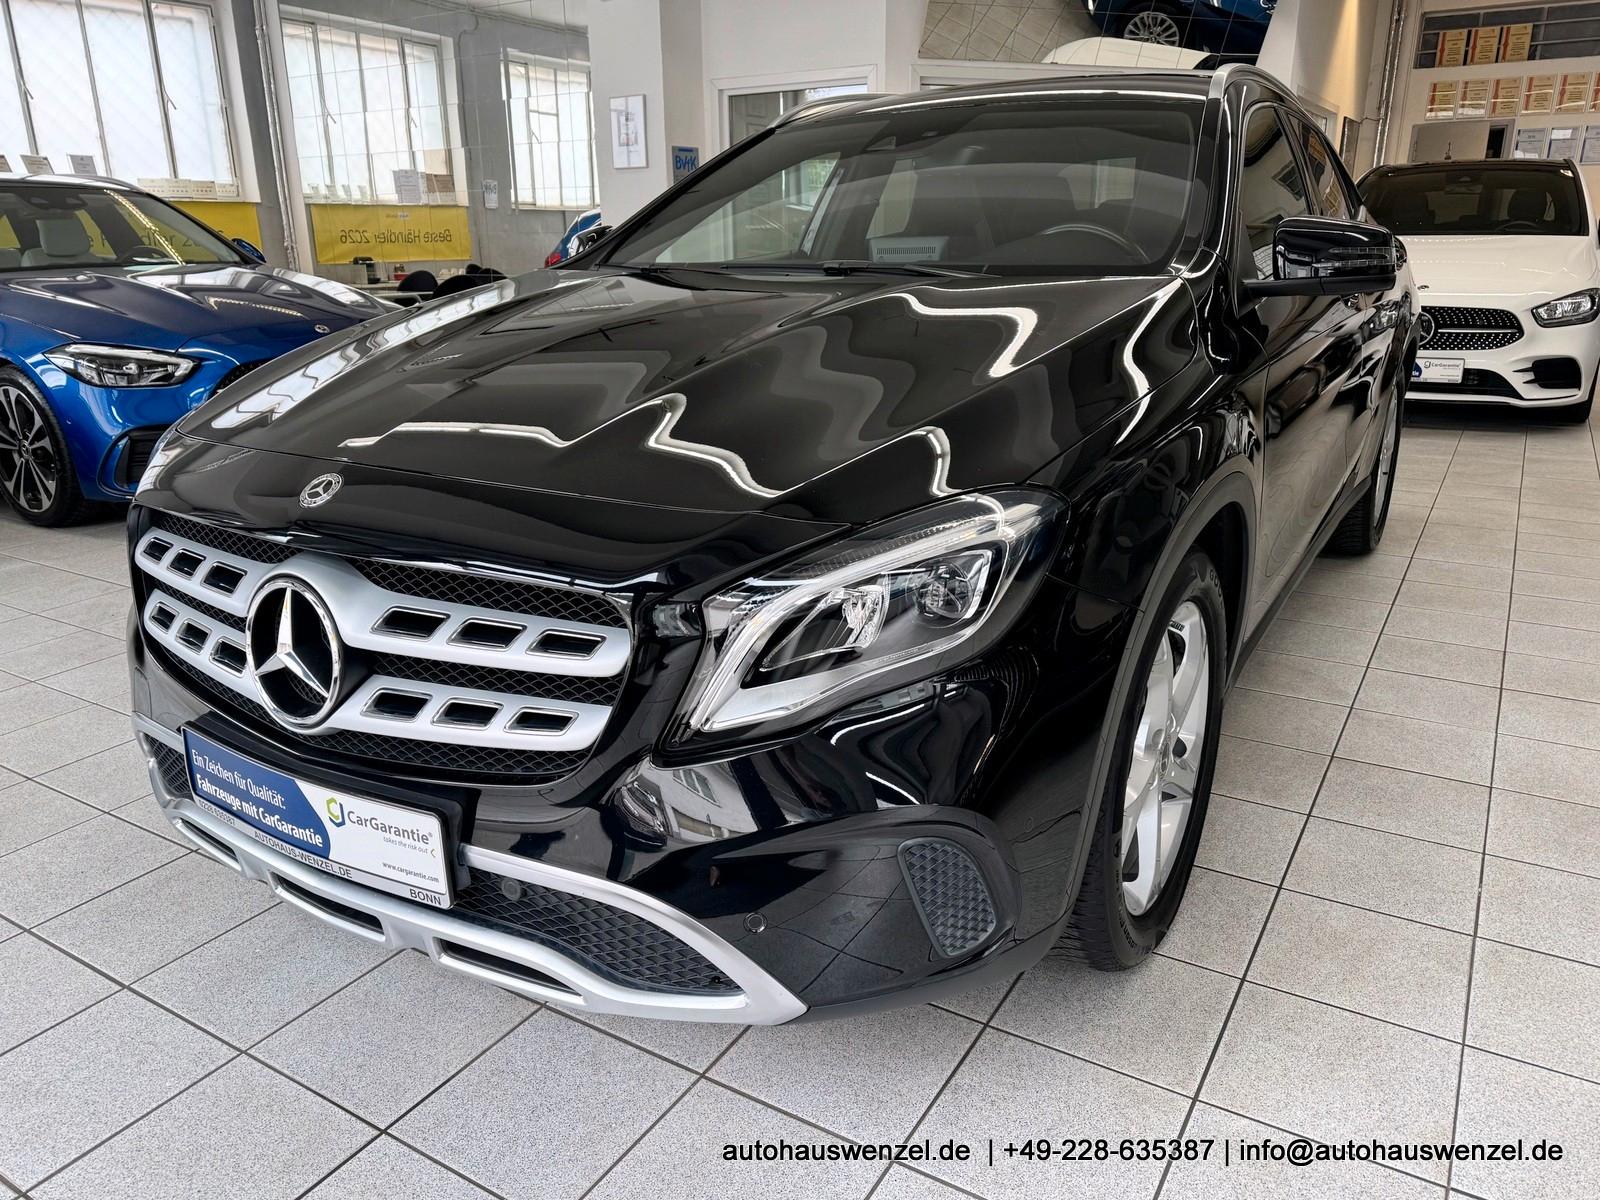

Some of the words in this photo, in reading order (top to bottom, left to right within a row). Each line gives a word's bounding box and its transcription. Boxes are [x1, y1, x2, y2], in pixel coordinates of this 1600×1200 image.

[191, 749, 206, 768] Ein
[204, 755, 235, 785] Zeichen
[234, 771, 247, 790] für
[246, 778, 286, 809] Qualität:
[196, 773, 242, 810] Fahrzeuge
[241, 800, 259, 820] mit
[258, 807, 323, 847] CarGarantie
[253, 830, 353, 880] AUTOHAUS-WENZEL.DE
[397, 840, 407, 848] the
[382, 862, 440, 883] www.cargarantie.com
[409, 888, 442, 906] BONN
